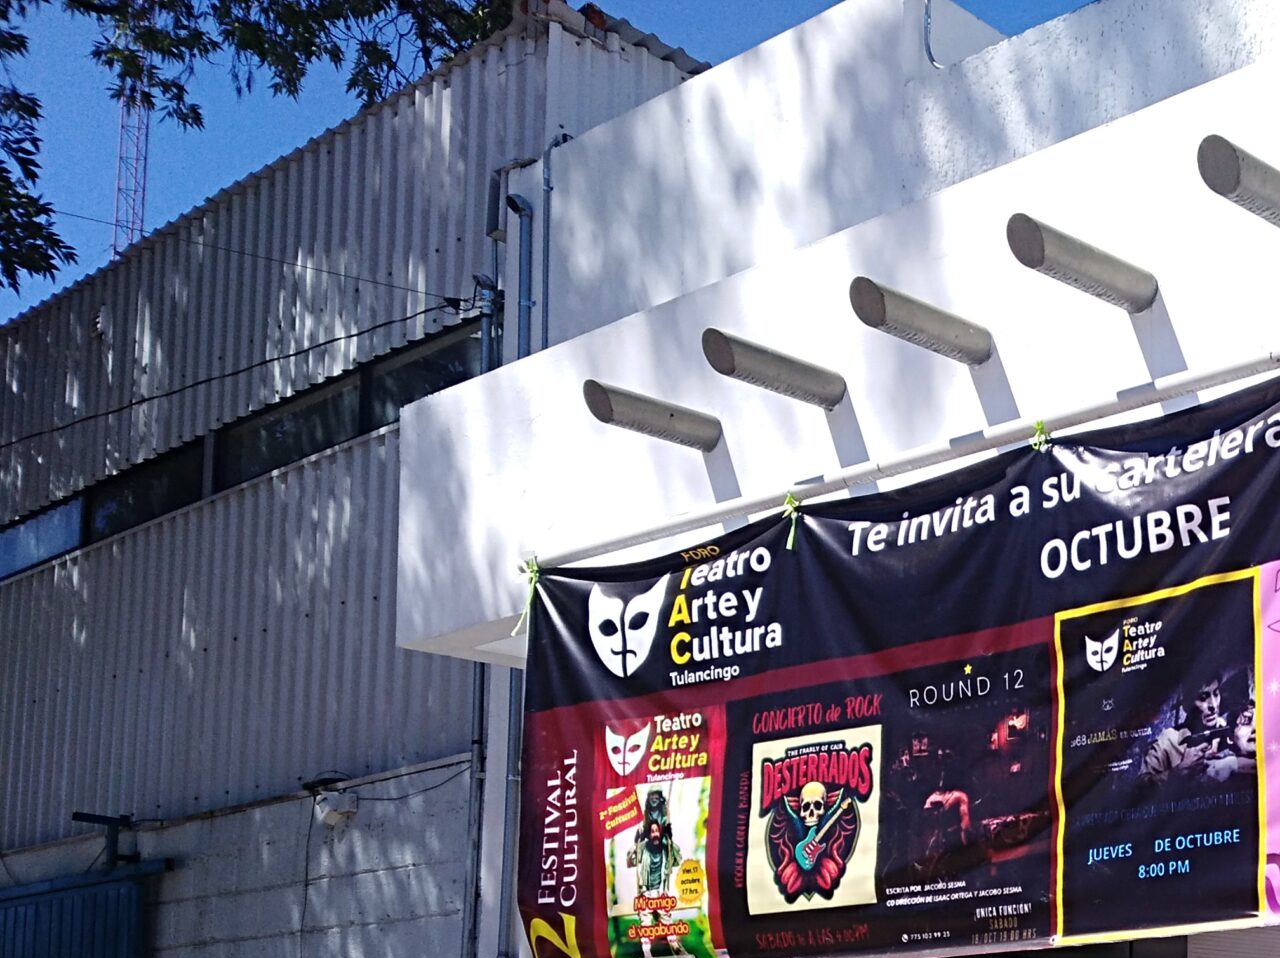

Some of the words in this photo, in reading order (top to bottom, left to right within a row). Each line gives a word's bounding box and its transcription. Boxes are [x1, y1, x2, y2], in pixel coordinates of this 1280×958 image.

[848, 520, 888, 557] Te
[898, 494, 996, 548] invita
[1009, 485, 1031, 518] a
[1042, 470, 1083, 511] su
[1040, 496, 1232, 579] OCTUBRE
[680, 545, 720, 563] FORO
[680, 546, 772, 590] Teatro
[668, 590, 738, 628] Arte
[742, 587, 764, 623] y
[1123, 620, 1163, 638] Teatro
[670, 621, 783, 665] Cultura
[1123, 637, 1149, 652] Arte
[1148, 634, 1157, 649] y
[1122, 646, 1166, 666] Cultura
[669, 665, 740, 687] Tulancingo
[909, 676, 991, 707] ROUND
[1003, 669, 1025, 691] 12
[654, 713, 702, 733] Teatro
[752, 702, 823, 735] CONCIERTO
[826, 704, 842, 723] de
[845, 694, 883, 720] ROCK
[650, 735, 687, 752] Arte
[687, 733, 700, 750] y
[648, 752, 708, 772] Cultura
[762, 746, 870, 810] DESTERRADOS
[609, 791, 638, 815] Festival
[537, 770, 562, 905] FESTIVAL
[560, 749, 578, 908] CULTURAL
[1088, 843, 1133, 865] JUEVES
[1154, 838, 1171, 853] DE
[1175, 829, 1241, 850] OCTUBRE
[1138, 862, 1165, 879] 8:00
[1169, 859, 1190, 875] PM
[680, 877, 700, 886] octubre
[886, 886, 910, 895] ESCRITA
[910, 885, 922, 893] POR
[924, 883, 947, 892] JACOBO
[947, 881, 967, 889] SESMA
[645, 895, 677, 912] amigo
[950, 891, 973, 900] ORTEGA
[978, 889, 1002, 897] JACOBO
[1003, 886, 1023, 895] SESMA
[628, 925, 637, 940] el
[637, 922, 689, 940] vagabundo
